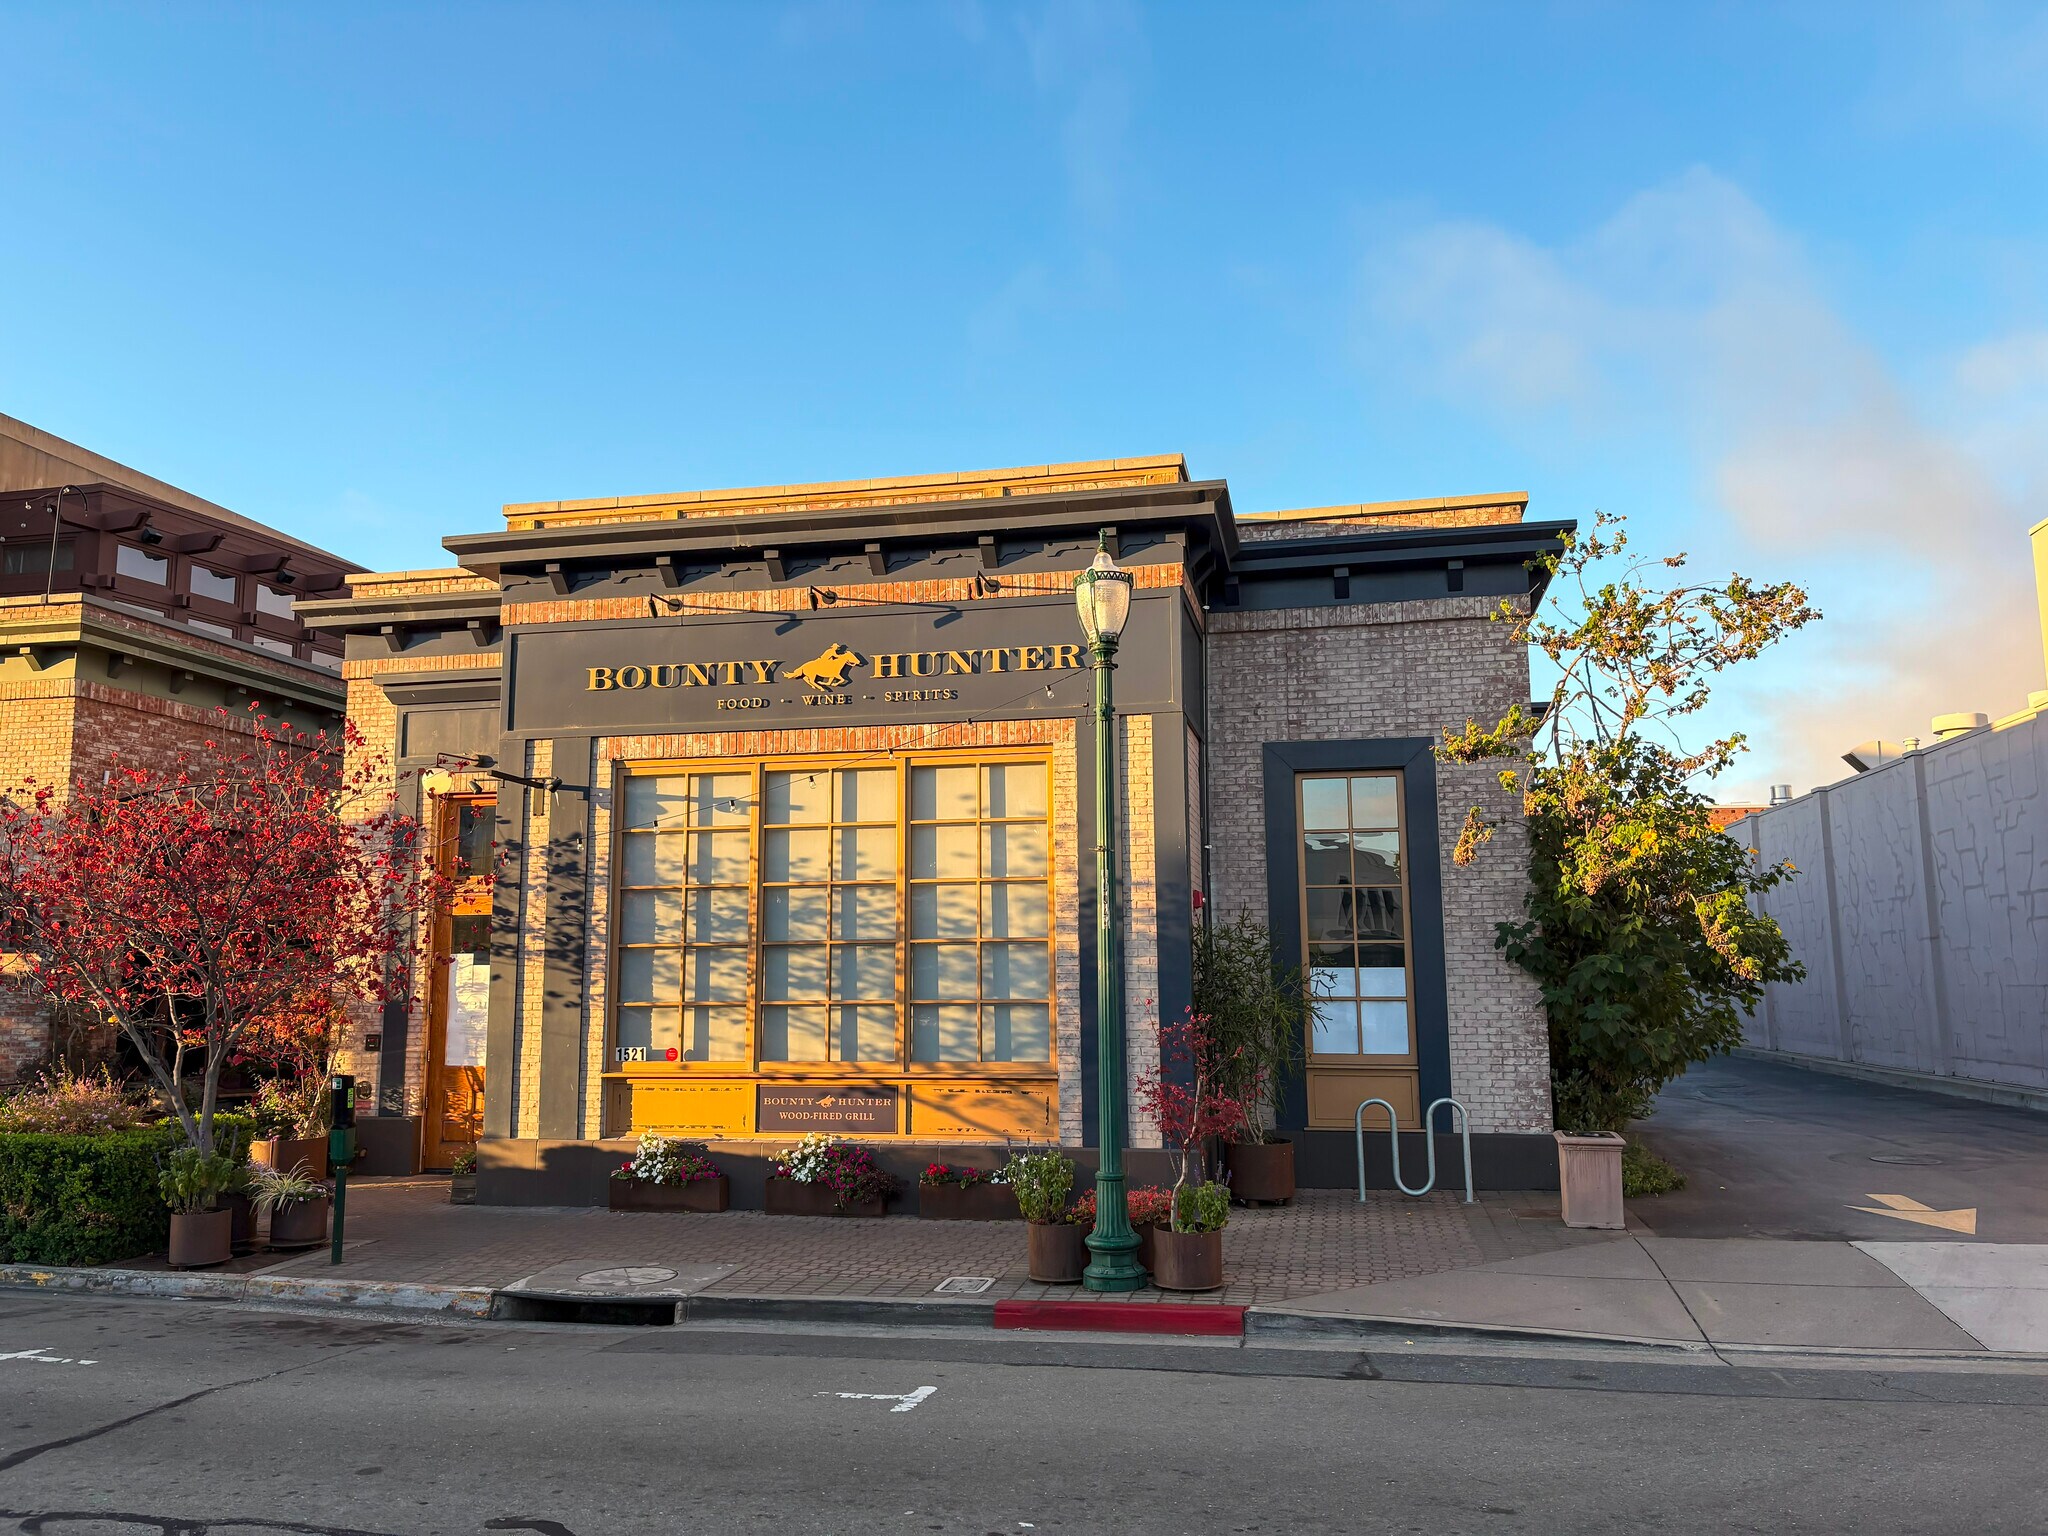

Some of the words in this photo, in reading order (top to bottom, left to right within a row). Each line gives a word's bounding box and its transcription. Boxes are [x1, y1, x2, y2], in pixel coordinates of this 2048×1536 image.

[585, 659, 778, 691] BOUNTY
[869, 643, 1082, 679] HUNTER
[717, 697, 763, 709] FOOD
[801, 693, 846, 705] WINE
[884, 688, 952, 702] SPIRITS
[617, 1047, 645, 1061] 1521
[763, 1097, 815, 1106] BOUNTY
[838, 1098, 892, 1106] HUNTER
[779, 1111, 843, 1120] WOOD-FIRED
[845, 1112, 875, 1121] GRILL
